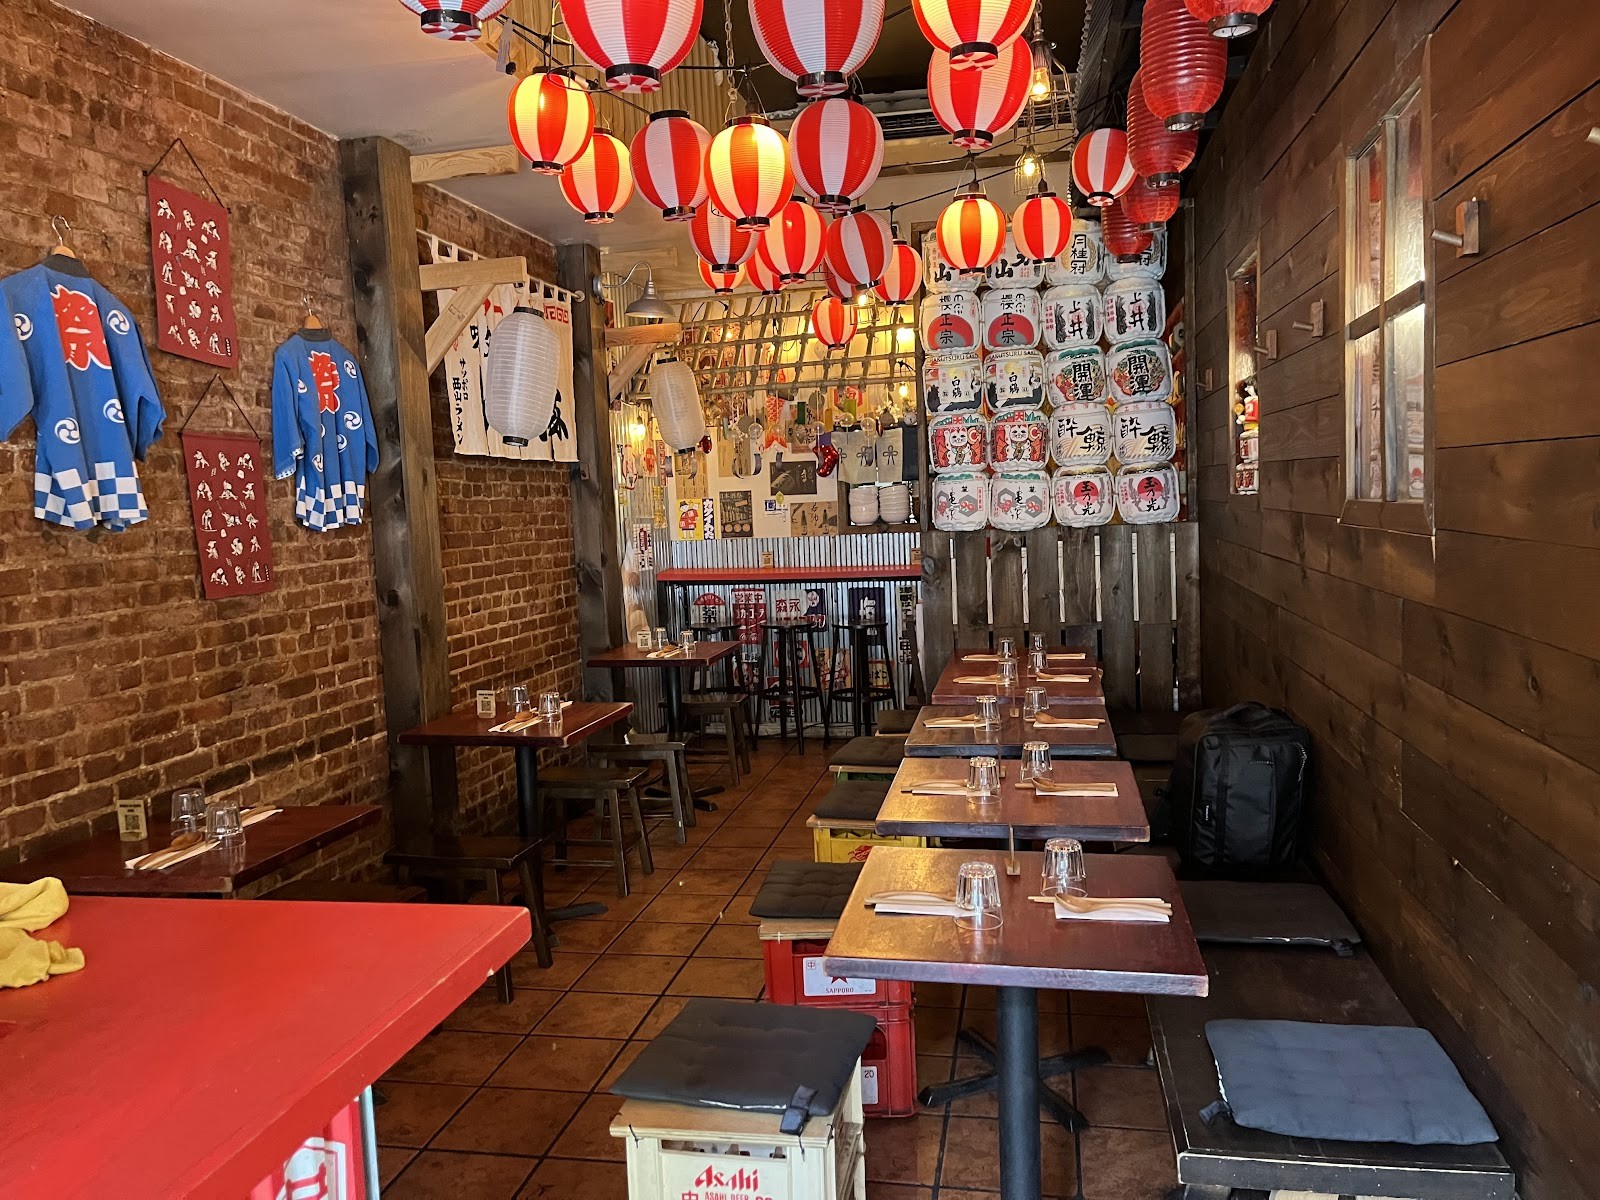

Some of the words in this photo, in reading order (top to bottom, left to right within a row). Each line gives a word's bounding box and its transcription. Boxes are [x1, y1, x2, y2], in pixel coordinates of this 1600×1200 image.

[1070, 234, 1088, 274] 月桂冠
[1072, 362, 1095, 401] 開運
[1128, 354, 1150, 395] 開運
[1057, 417, 1106, 452] 酔鯨
[1120, 416, 1171, 453] 酔鯨
[1081, 480, 1095, 515] 玉乃光
[1143, 476, 1160, 512] 玉乃光
[776, 599, 801, 612] 森永
[864, 1069, 875, 1079] 20
[695, 1164, 758, 1192] Asahi
